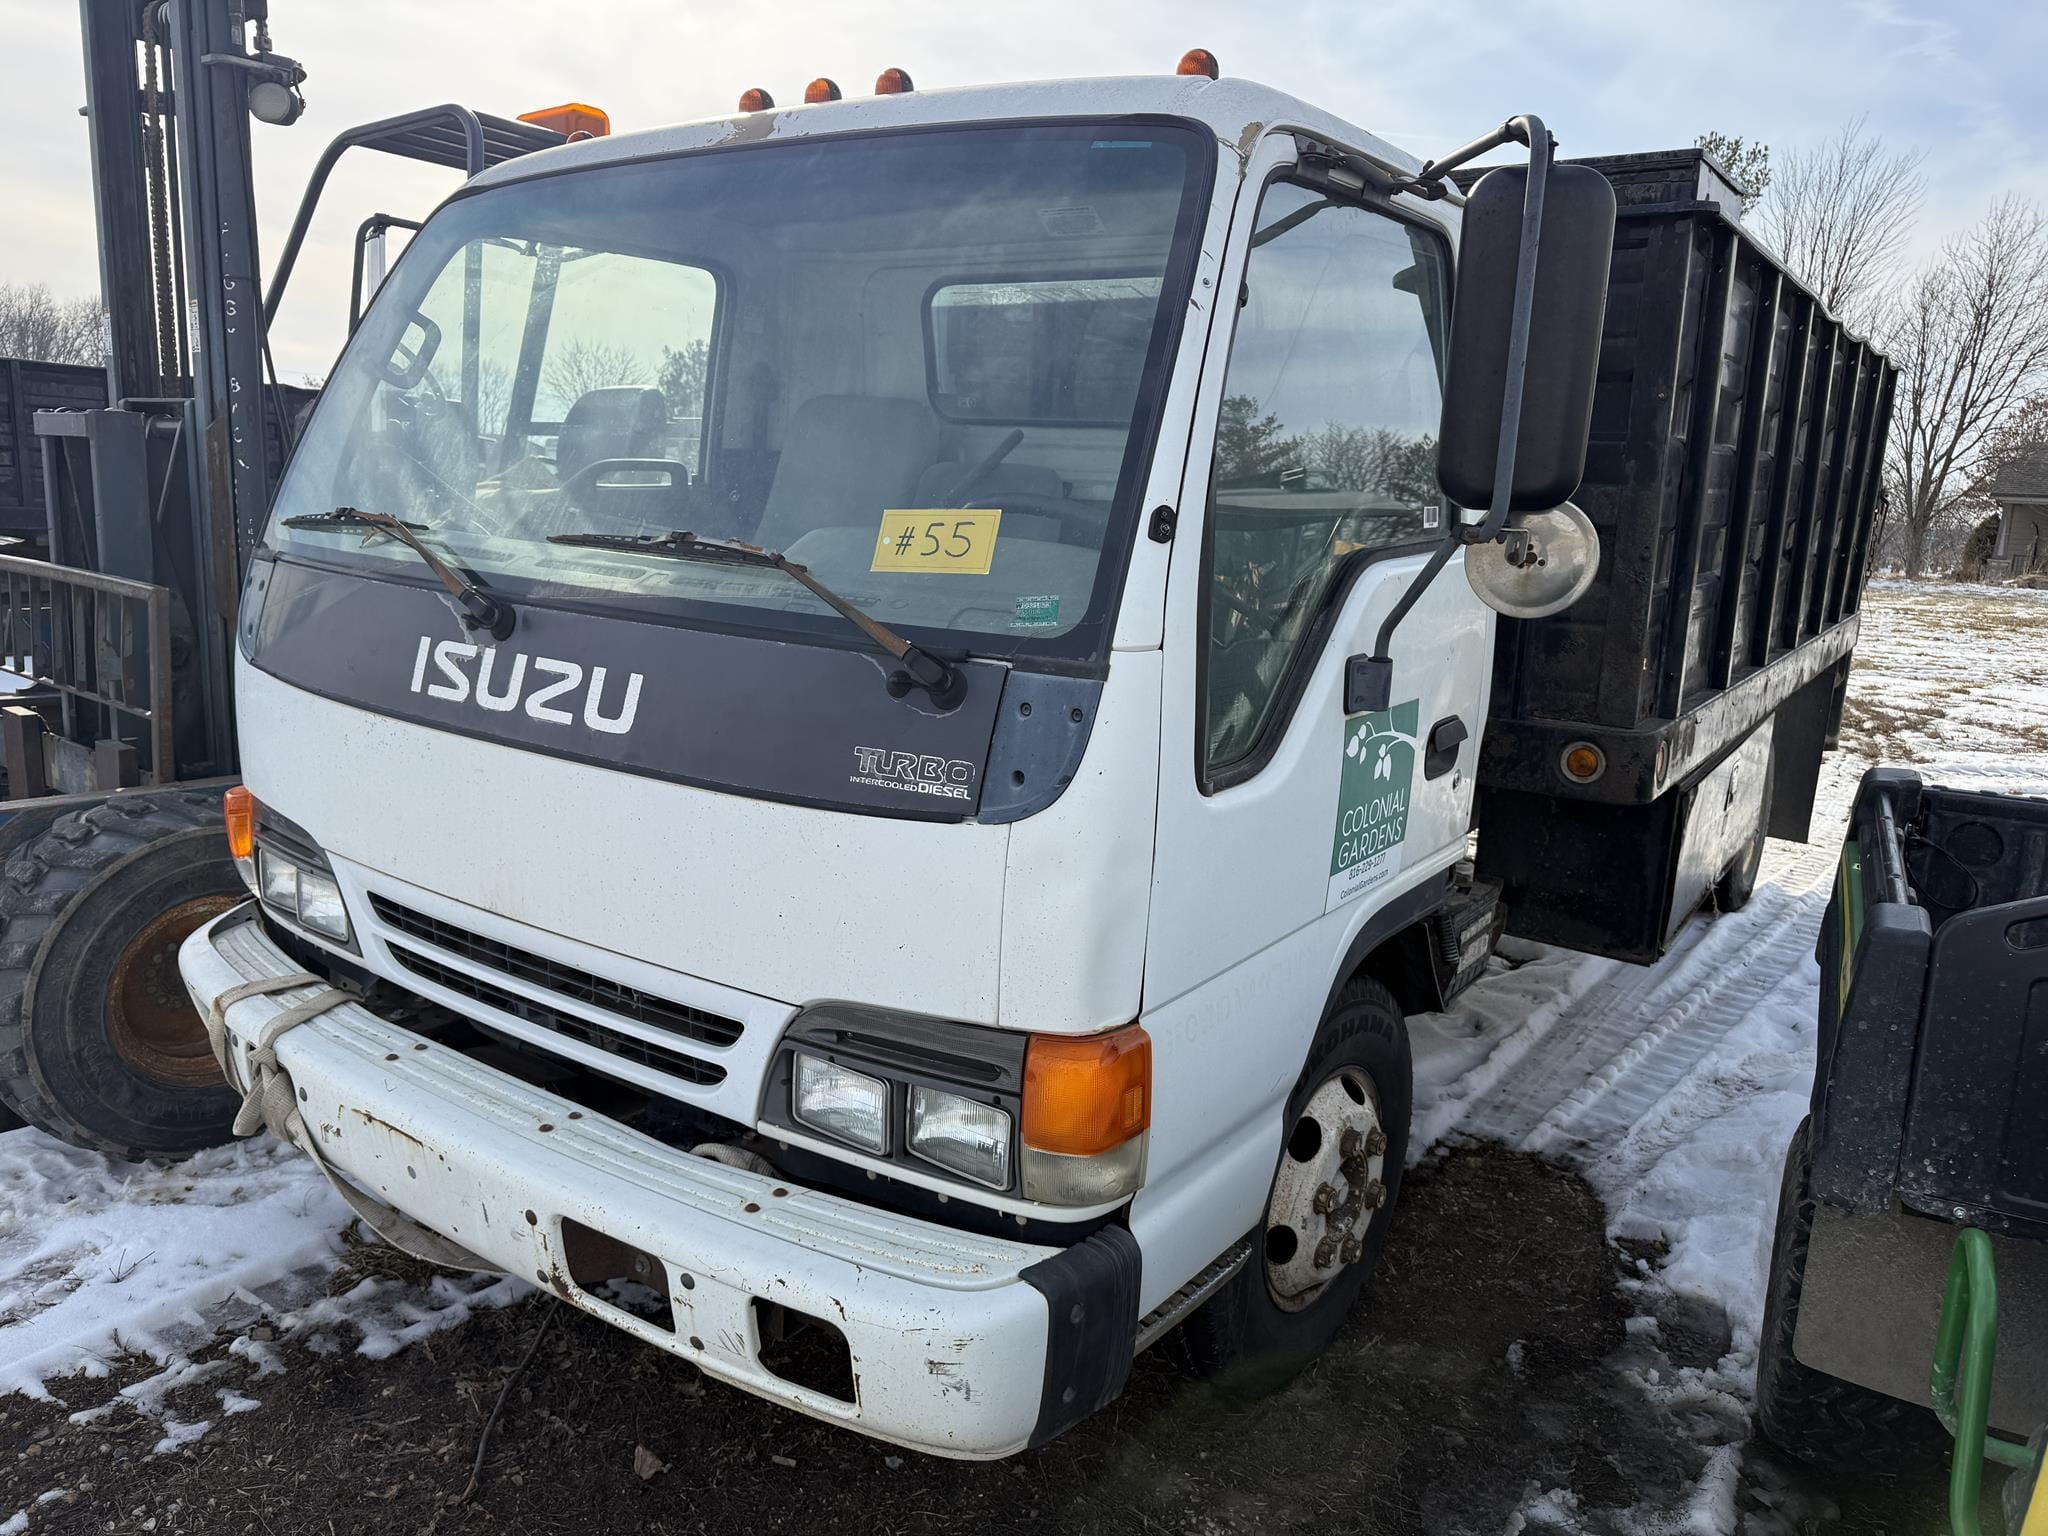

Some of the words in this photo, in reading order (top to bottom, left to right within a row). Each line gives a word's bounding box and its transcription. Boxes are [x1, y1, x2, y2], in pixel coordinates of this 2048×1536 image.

[895, 521, 976, 558] #55
[410, 635, 644, 734] ISUZU
[854, 746, 975, 787] TURBO
[1342, 787, 1405, 837] COLONIAL
[1338, 816, 1403, 868] GARDENS
[1340, 868, 1389, 900] ColonialGardens.com
[1348, 851, 1386, 880] 816-229-1277
